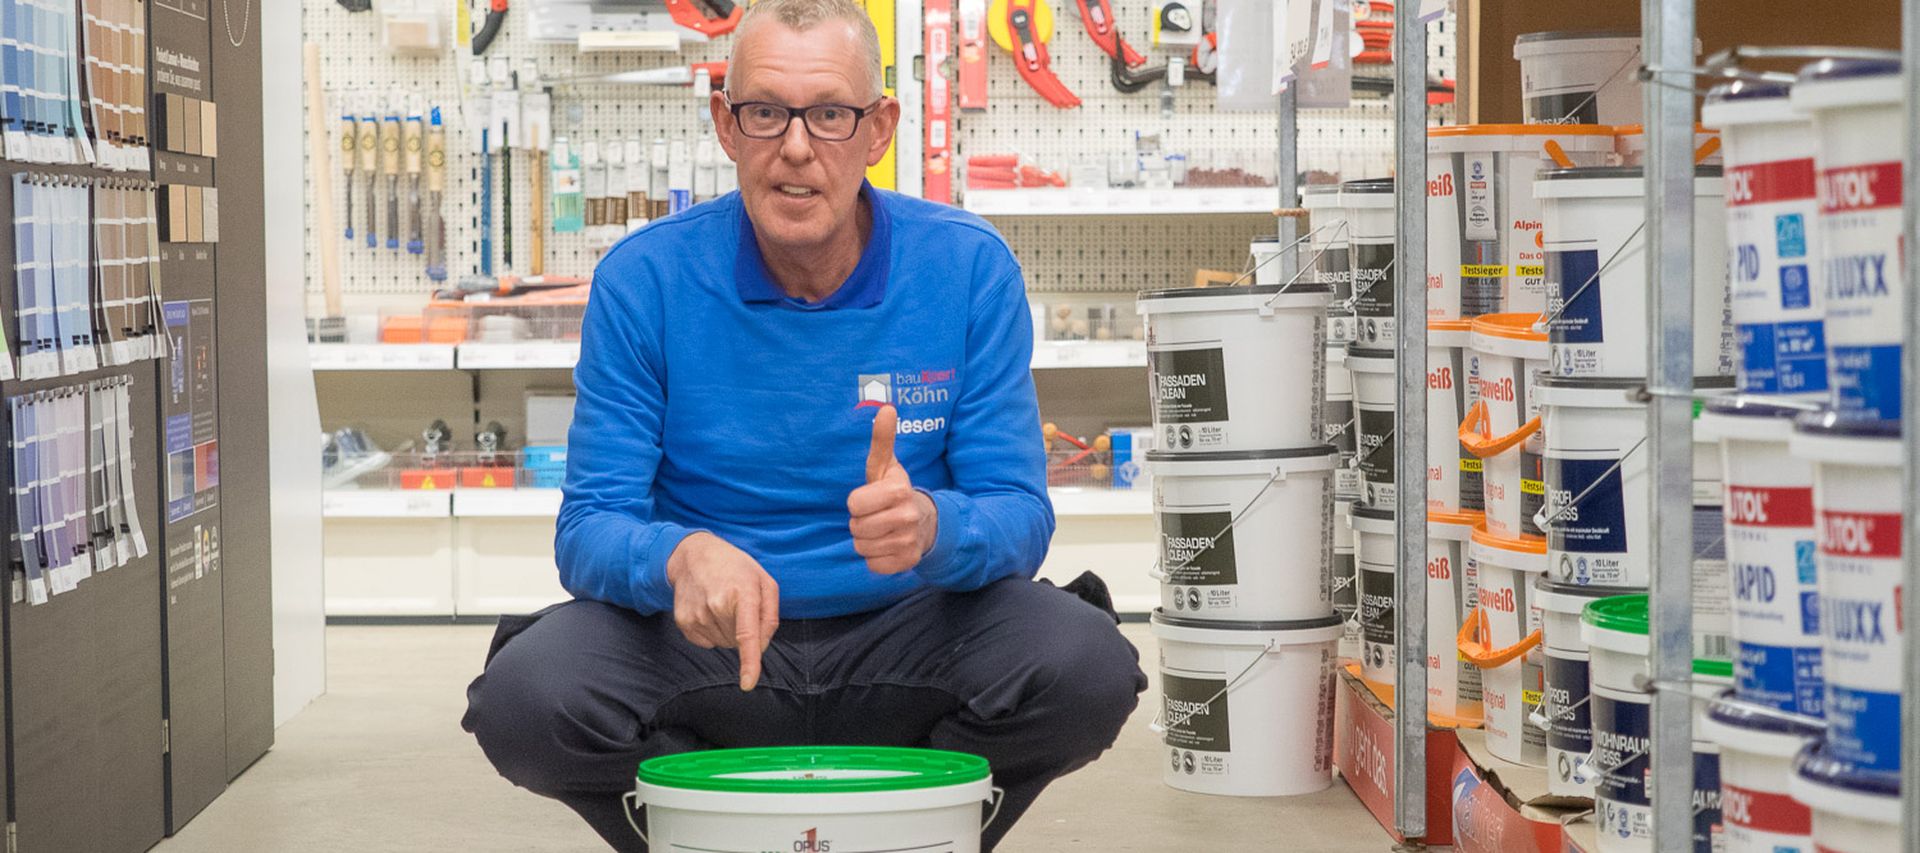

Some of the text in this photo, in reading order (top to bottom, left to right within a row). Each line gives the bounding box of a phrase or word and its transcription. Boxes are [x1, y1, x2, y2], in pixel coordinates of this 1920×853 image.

[1514, 221, 1543, 231] Alpin
[1464, 266, 1503, 276] Testsieger
[1160, 373, 1206, 387] FASSADEN
[898, 386, 949, 404] Köhn
[1161, 387, 1186, 400] CLEAN
[1168, 536, 1215, 549] FASSADEN
[1168, 549, 1194, 561] CLEAN
[1168, 698, 1210, 716] FASSADEN
[1168, 710, 1191, 726] CLEAN
[793, 840, 831, 853] OPUS
